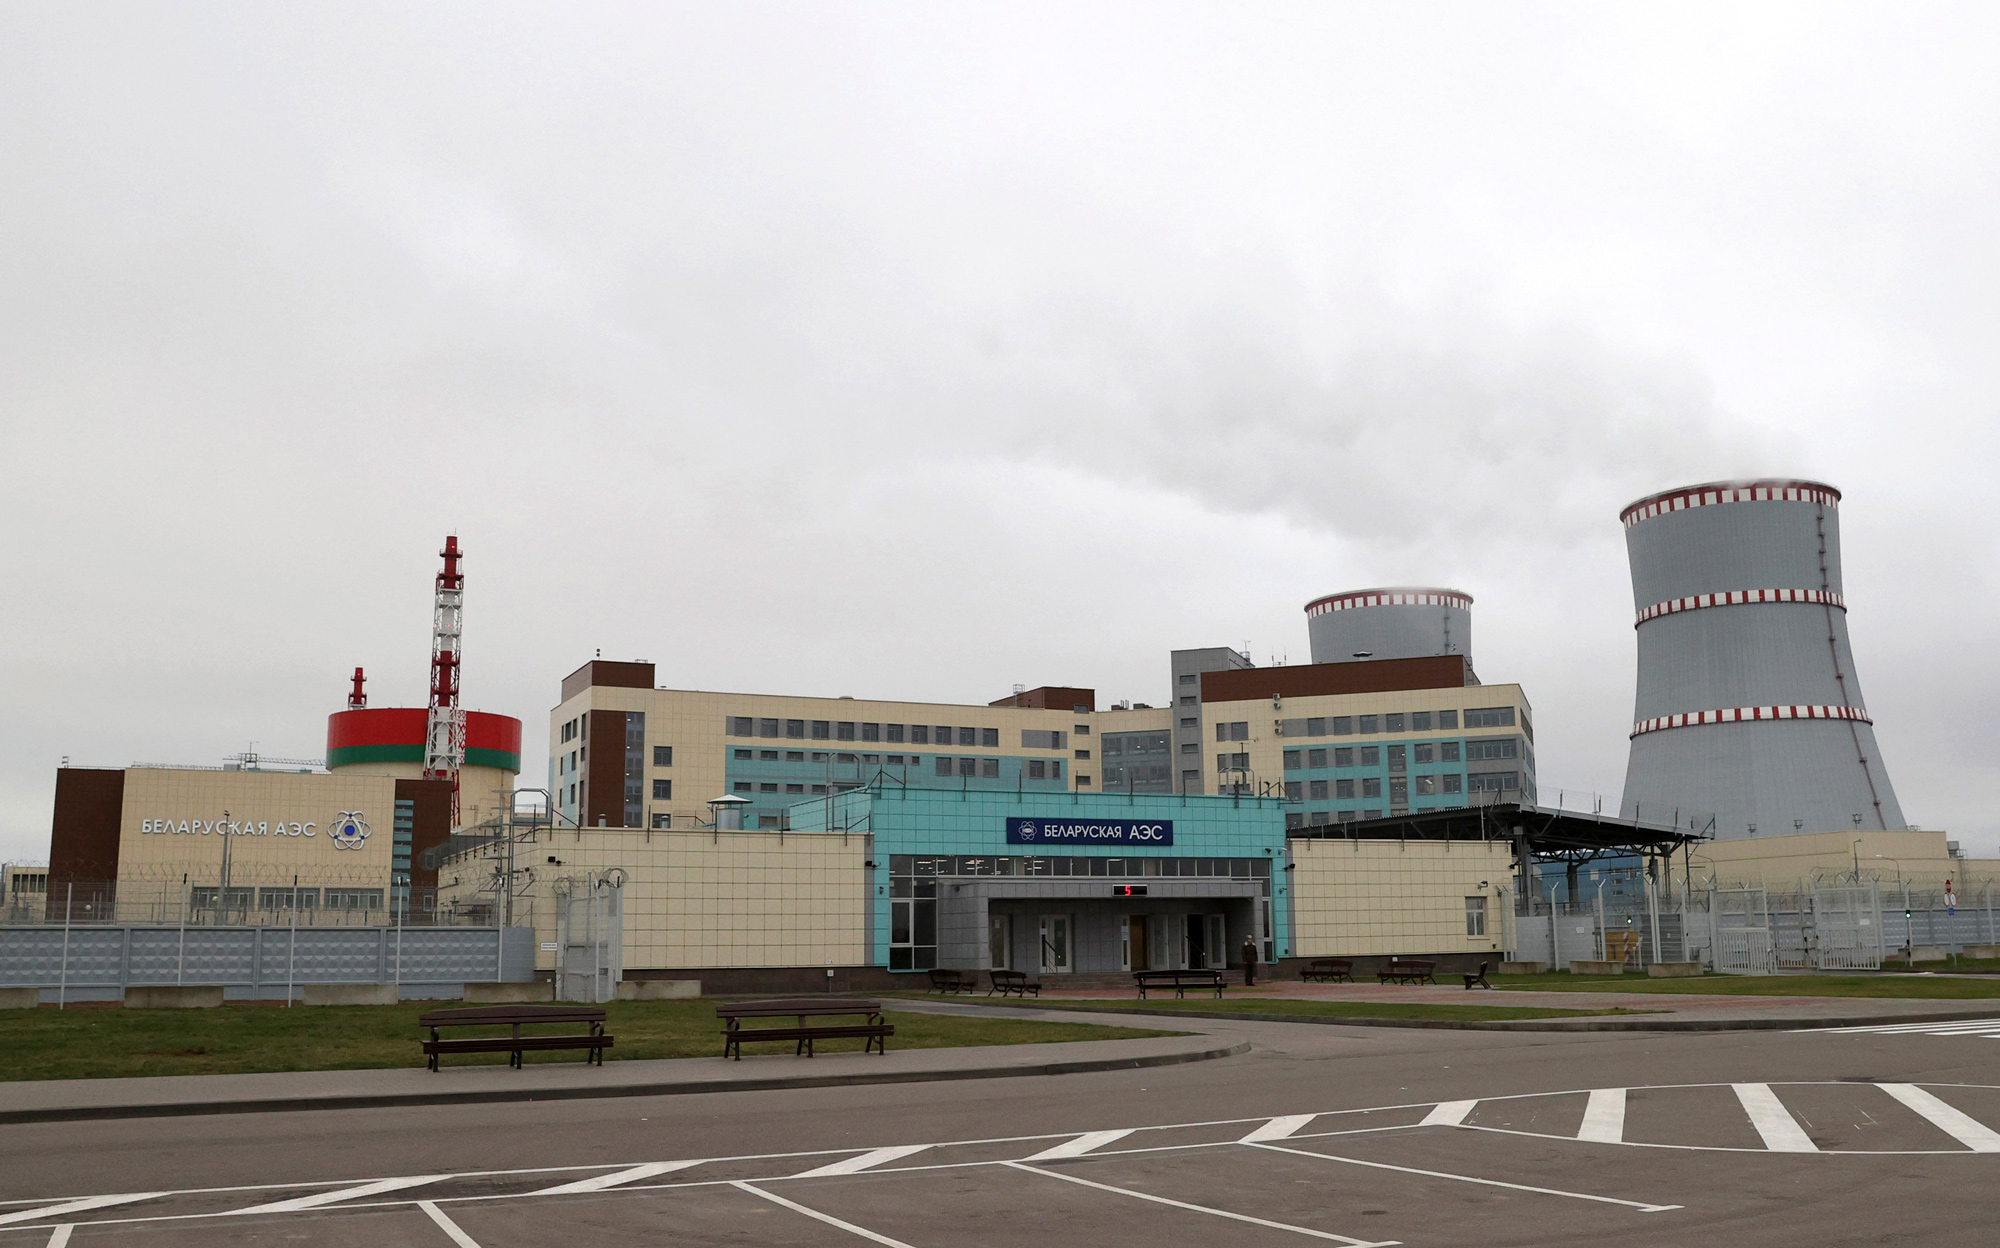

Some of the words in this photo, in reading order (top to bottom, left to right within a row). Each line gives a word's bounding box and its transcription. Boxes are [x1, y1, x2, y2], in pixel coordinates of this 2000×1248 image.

[142, 819, 268, 835] БЕЛАРУСКАЯ
[273, 821, 317, 837] АЭС
[1044, 825, 1122, 838] БЕЛАРУСКАЯ
[1129, 825, 1163, 840] АЭС
[1125, 885, 1132, 896] 5
